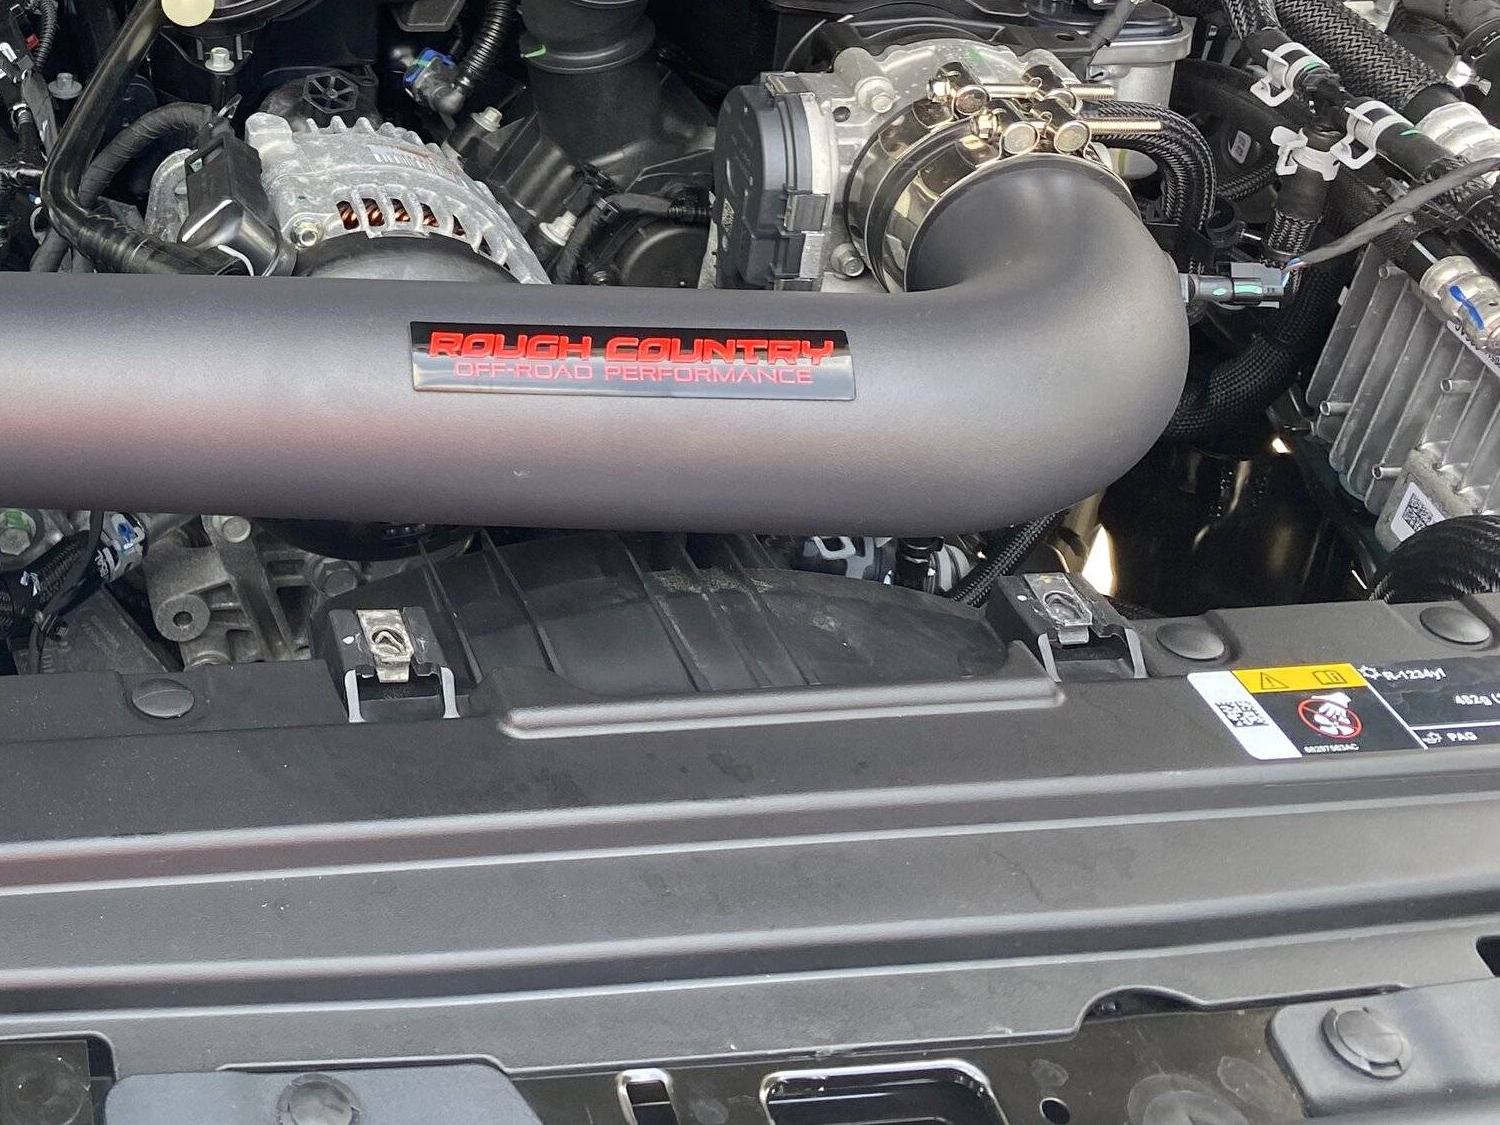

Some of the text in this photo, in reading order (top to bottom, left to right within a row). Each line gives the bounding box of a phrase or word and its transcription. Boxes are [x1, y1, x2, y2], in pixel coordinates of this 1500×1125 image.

[428, 331, 835, 366] ROUGH COUNTRY
[453, 362, 814, 384] OFF-ROAD PERFORMANCE
[1446, 731, 1478, 742] PAG
